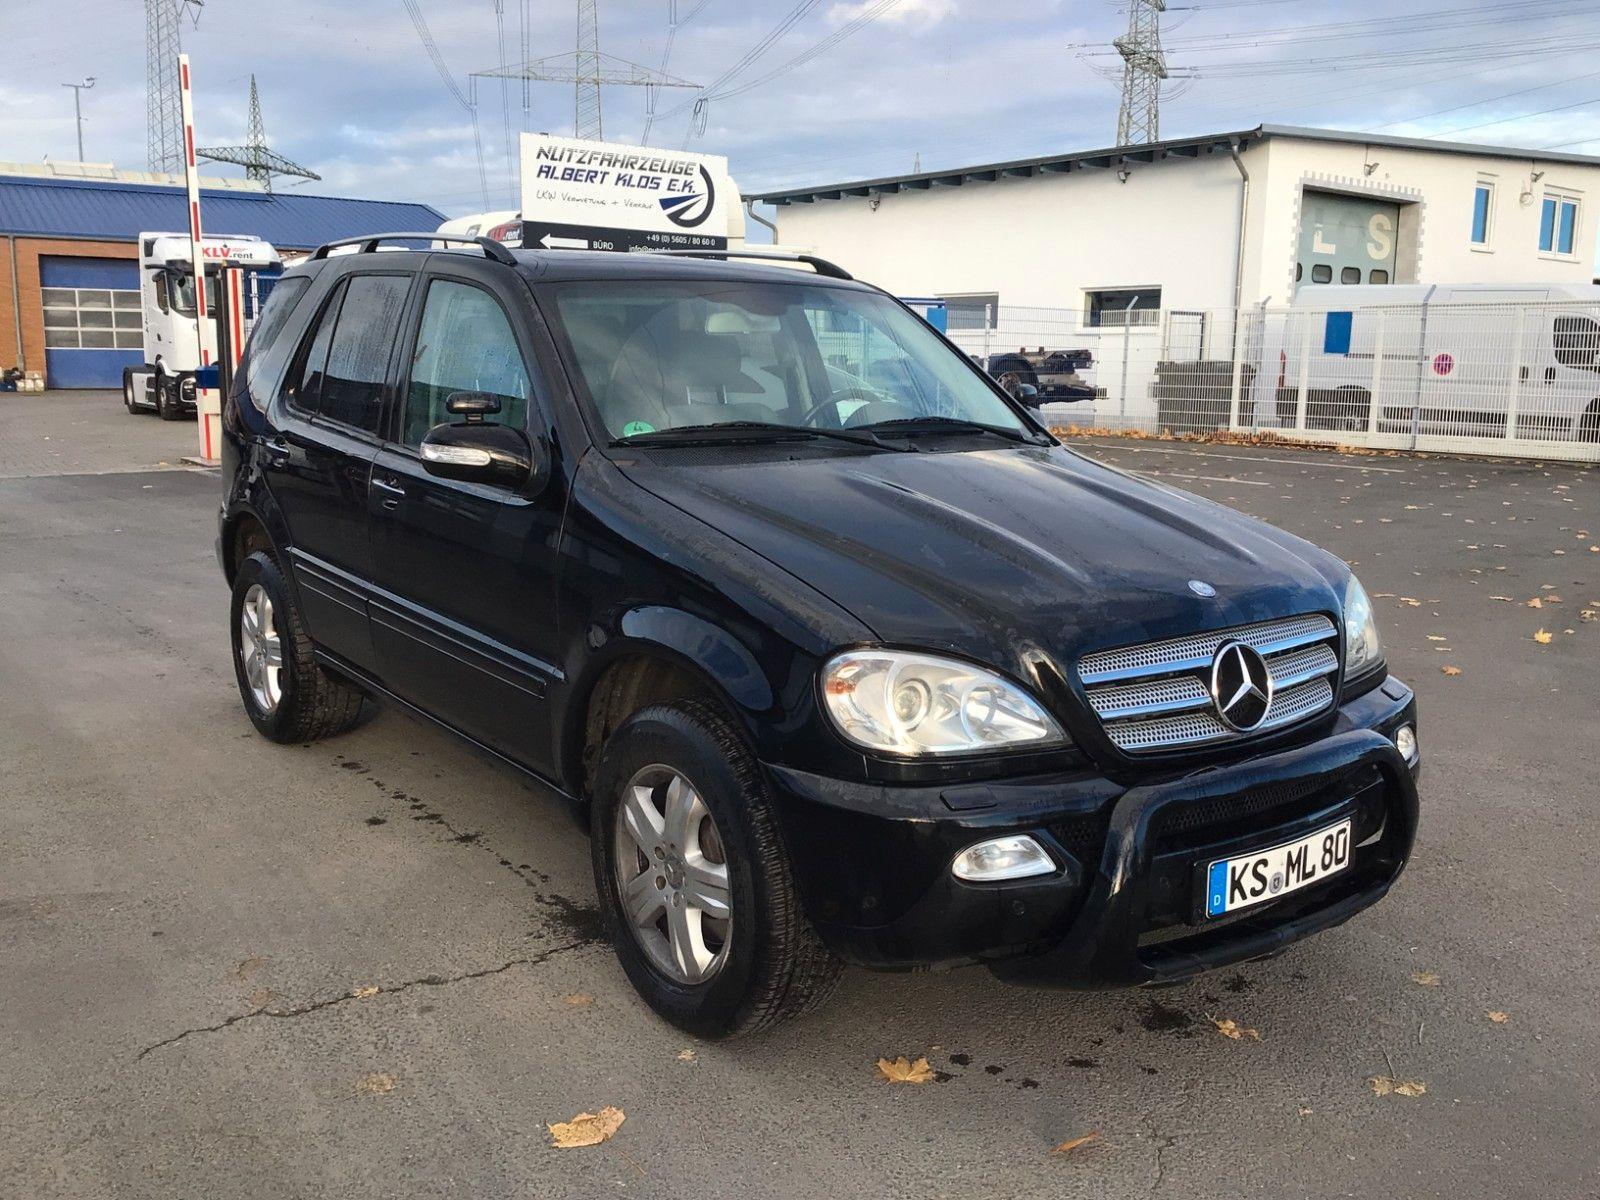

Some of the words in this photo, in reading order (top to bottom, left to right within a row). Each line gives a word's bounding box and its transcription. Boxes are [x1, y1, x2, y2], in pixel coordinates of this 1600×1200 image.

[536, 146, 696, 176] NUTZFAHRZEUGE
[536, 165, 610, 184] ALBERT
[614, 173, 662, 190] KLOS
[667, 178, 696, 193] E.K.
[536, 189, 556, 200] LKW
[593, 239, 613, 250] BÜRO
[646, 234, 659, 242] +49
[661, 235, 670, 243] (0)
[1229, 858, 1268, 904] KS
[1285, 844, 1316, 887] ML
[1321, 827, 1348, 871] 80
[1213, 894, 1221, 906] D
